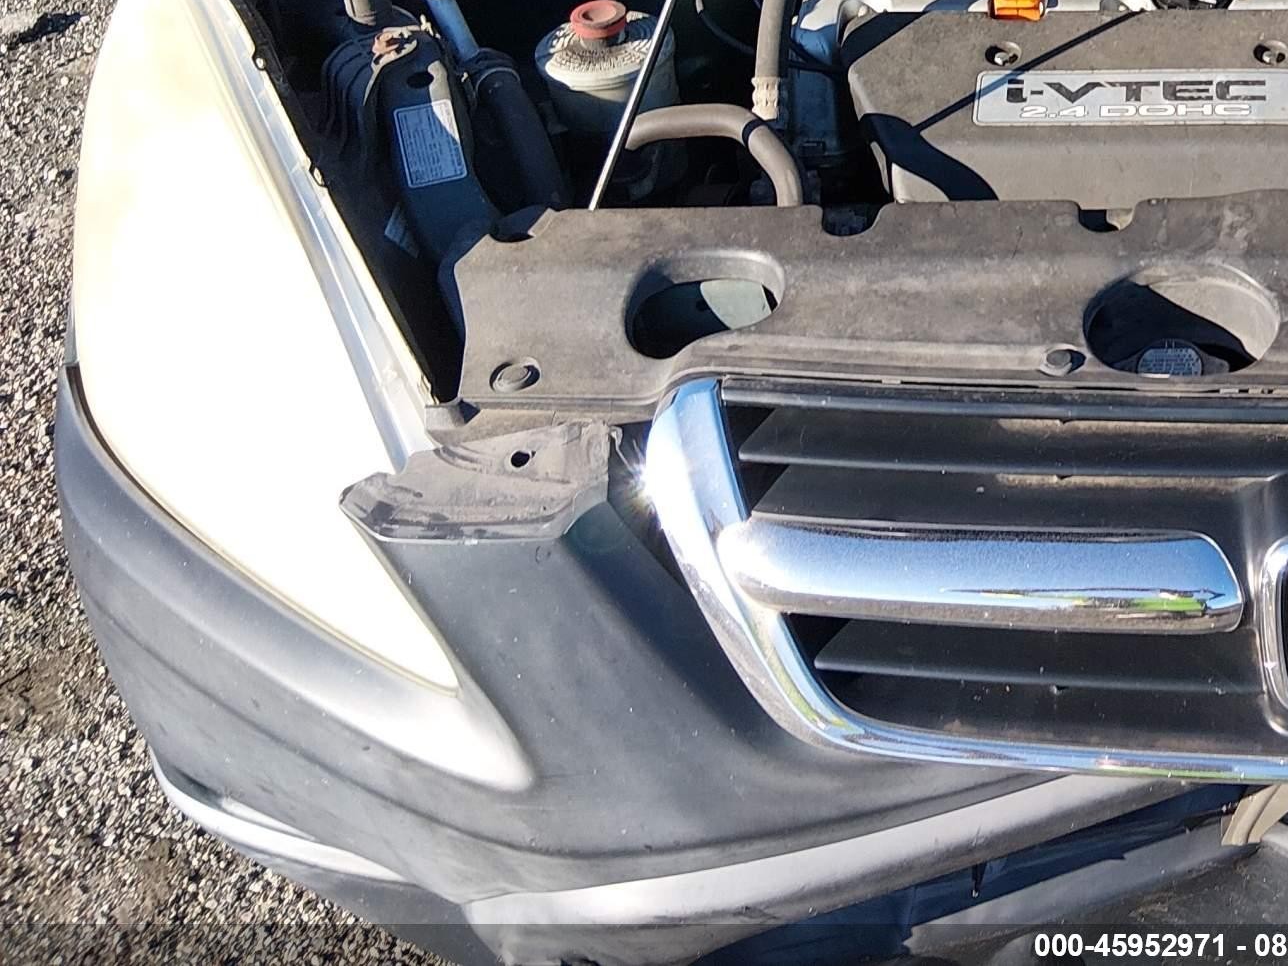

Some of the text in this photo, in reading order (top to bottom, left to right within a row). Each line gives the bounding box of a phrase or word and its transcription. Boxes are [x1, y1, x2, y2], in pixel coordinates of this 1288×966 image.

[1006, 78, 1267, 104] i-VTEC
[1019, 104, 1251, 119] 2.4 DOHC
